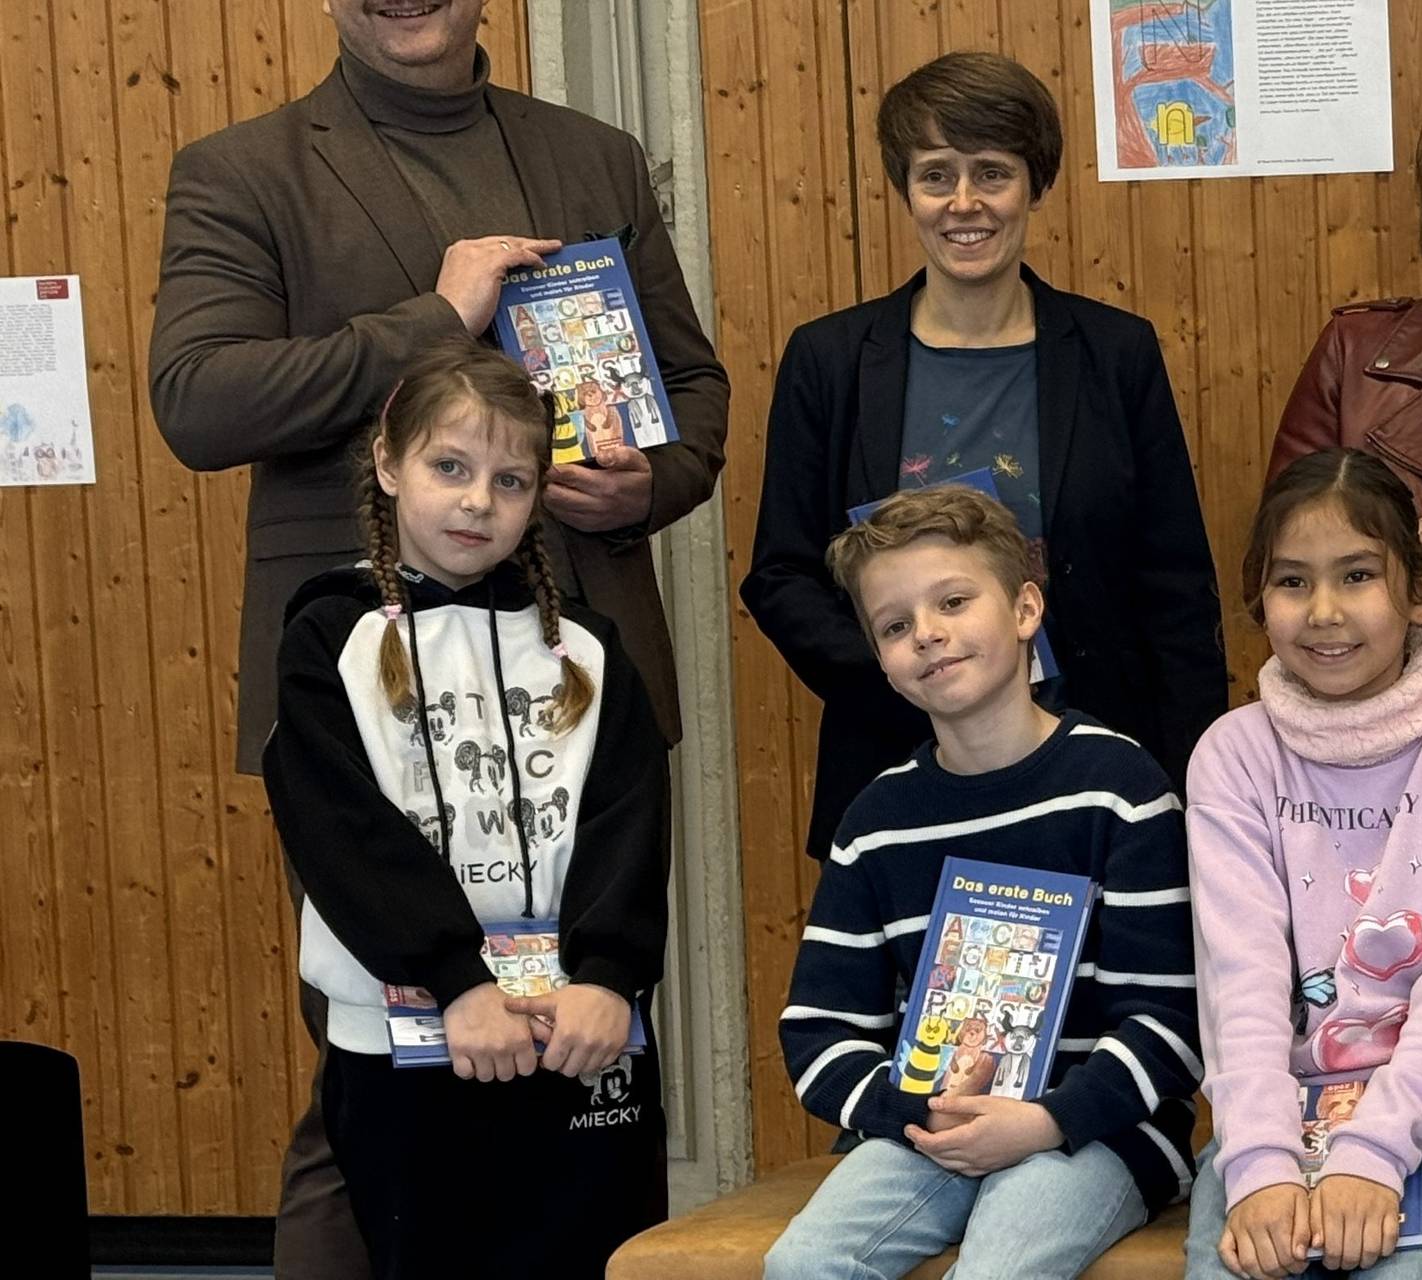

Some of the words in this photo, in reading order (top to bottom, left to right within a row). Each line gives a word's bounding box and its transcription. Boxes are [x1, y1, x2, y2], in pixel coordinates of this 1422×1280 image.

[532, 264, 571, 279] erste
[575, 256, 615, 272] Buch
[466, 693, 484, 720] T
[525, 750, 554, 779] C
[477, 810, 505, 835] W
[455, 860, 538, 884] iECKY
[953, 876, 983, 893] Das
[988, 884, 1029, 899] erste
[1032, 888, 1073, 906] Buch
